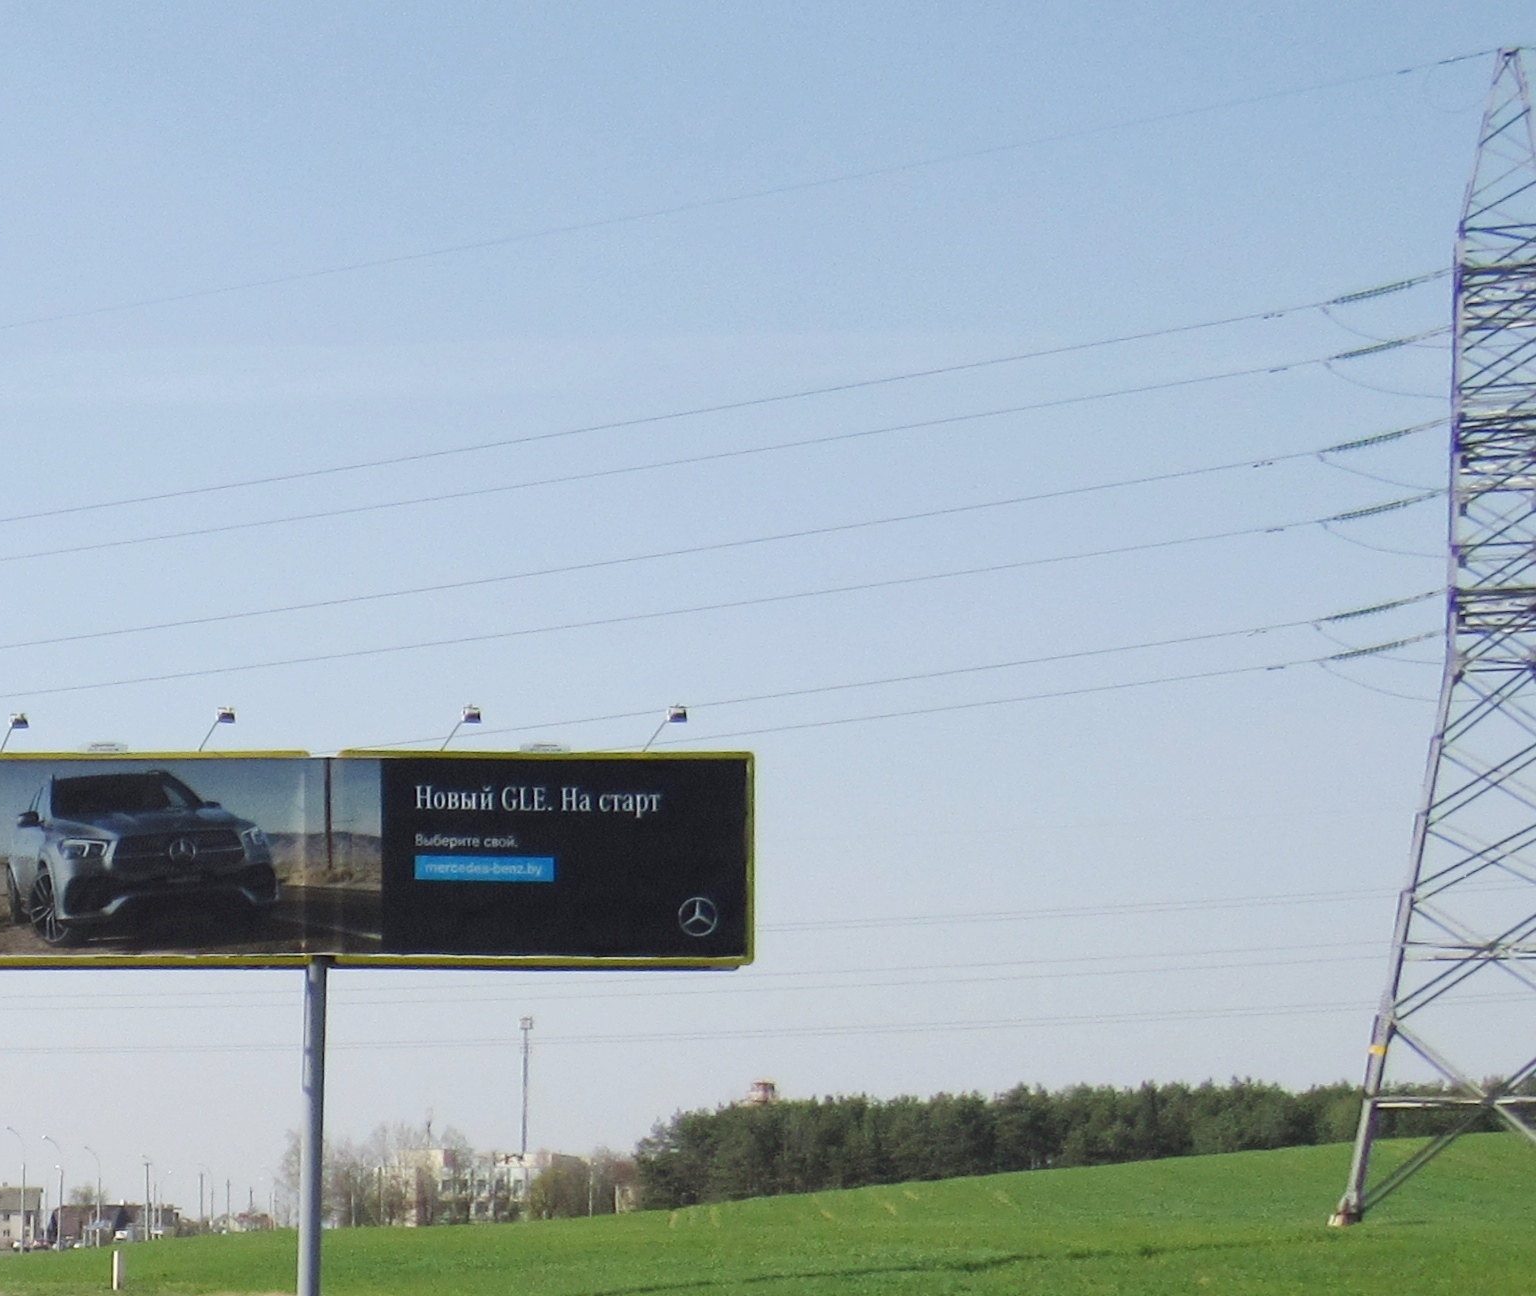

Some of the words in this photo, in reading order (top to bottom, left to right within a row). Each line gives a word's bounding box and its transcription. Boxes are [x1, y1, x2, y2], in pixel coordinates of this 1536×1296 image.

[415, 785, 494, 811] Новый
[501, 786, 553, 812] GLE.
[561, 787, 592, 812] На
[599, 793, 661, 818] старт
[415, 834, 480, 849] Выберите
[483, 836, 518, 848] свой.
[425, 862, 542, 876] mercedes-benz.by
